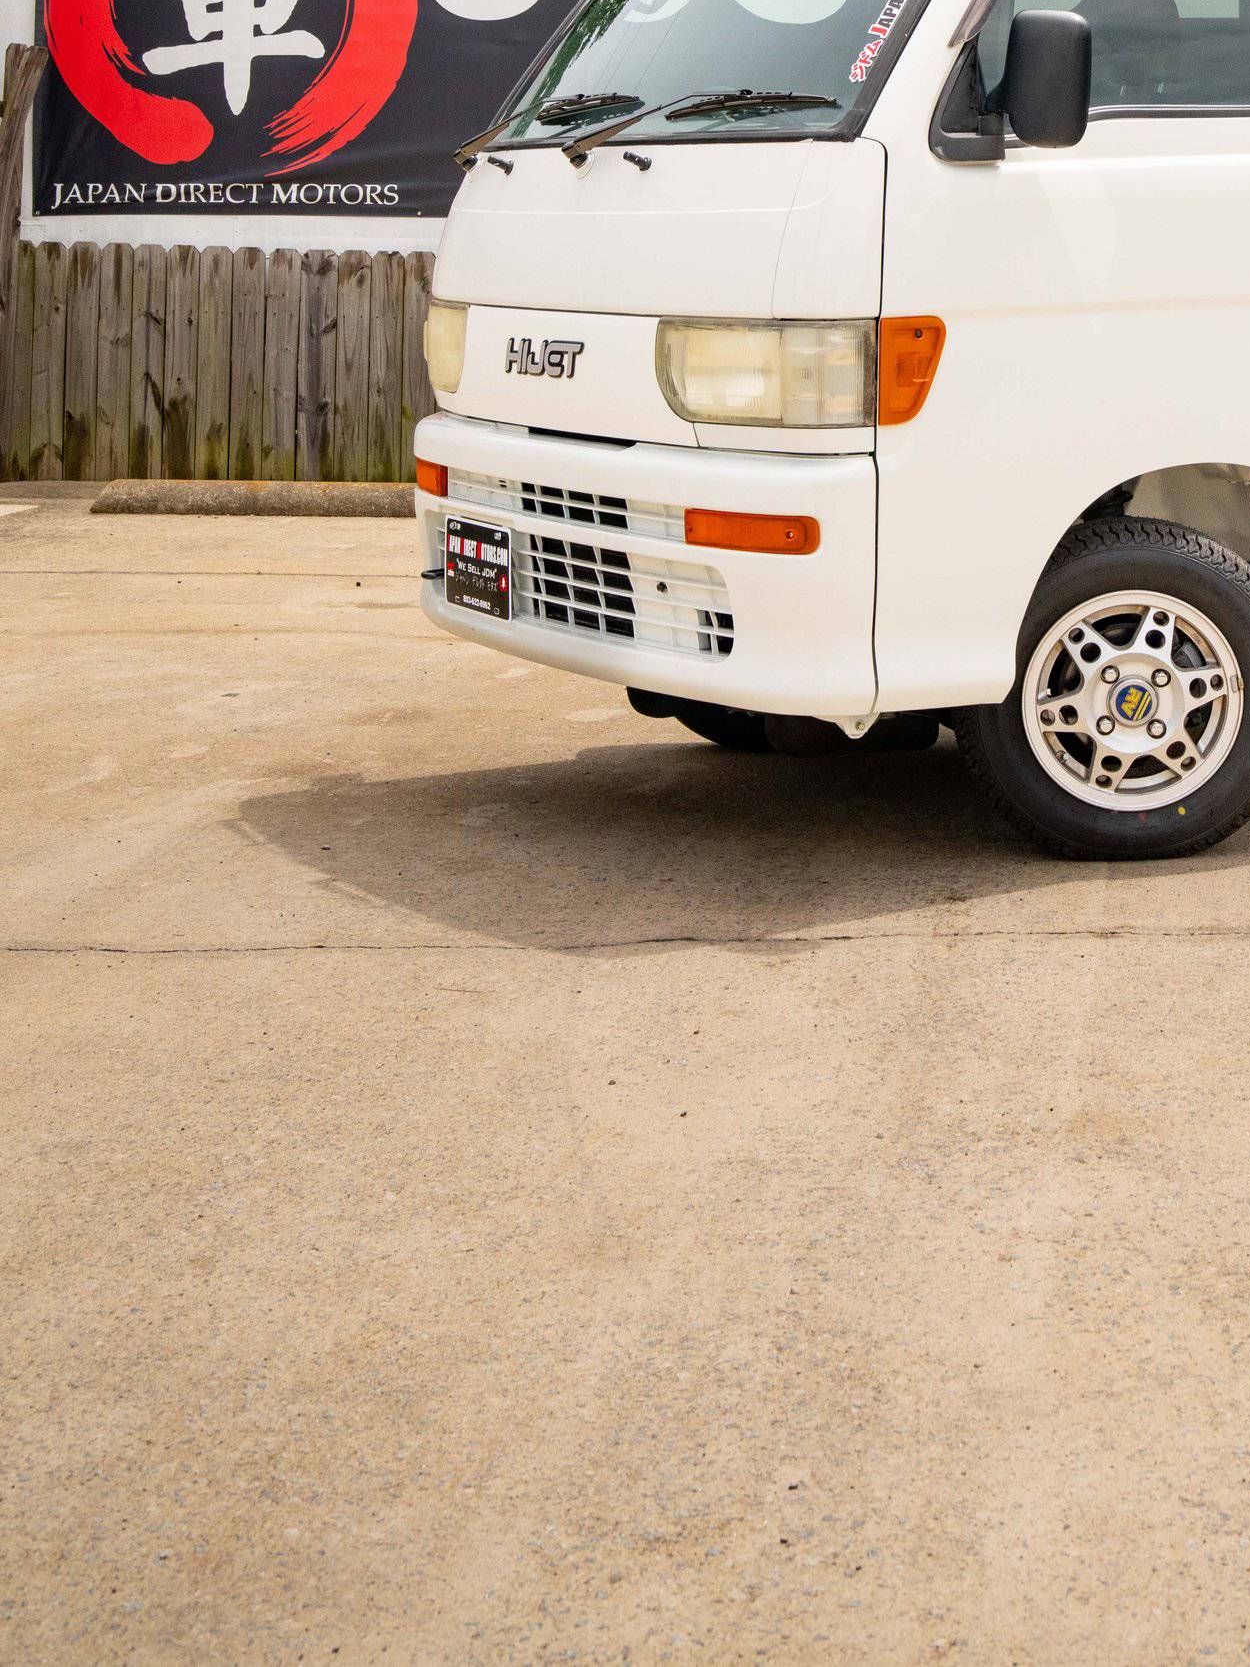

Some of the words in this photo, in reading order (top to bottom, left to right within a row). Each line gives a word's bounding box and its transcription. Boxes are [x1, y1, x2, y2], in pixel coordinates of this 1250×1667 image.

[51, 182, 146, 209] JAPAN
[155, 183, 264, 203] DIRECT
[271, 183, 399, 205] MOTORS
